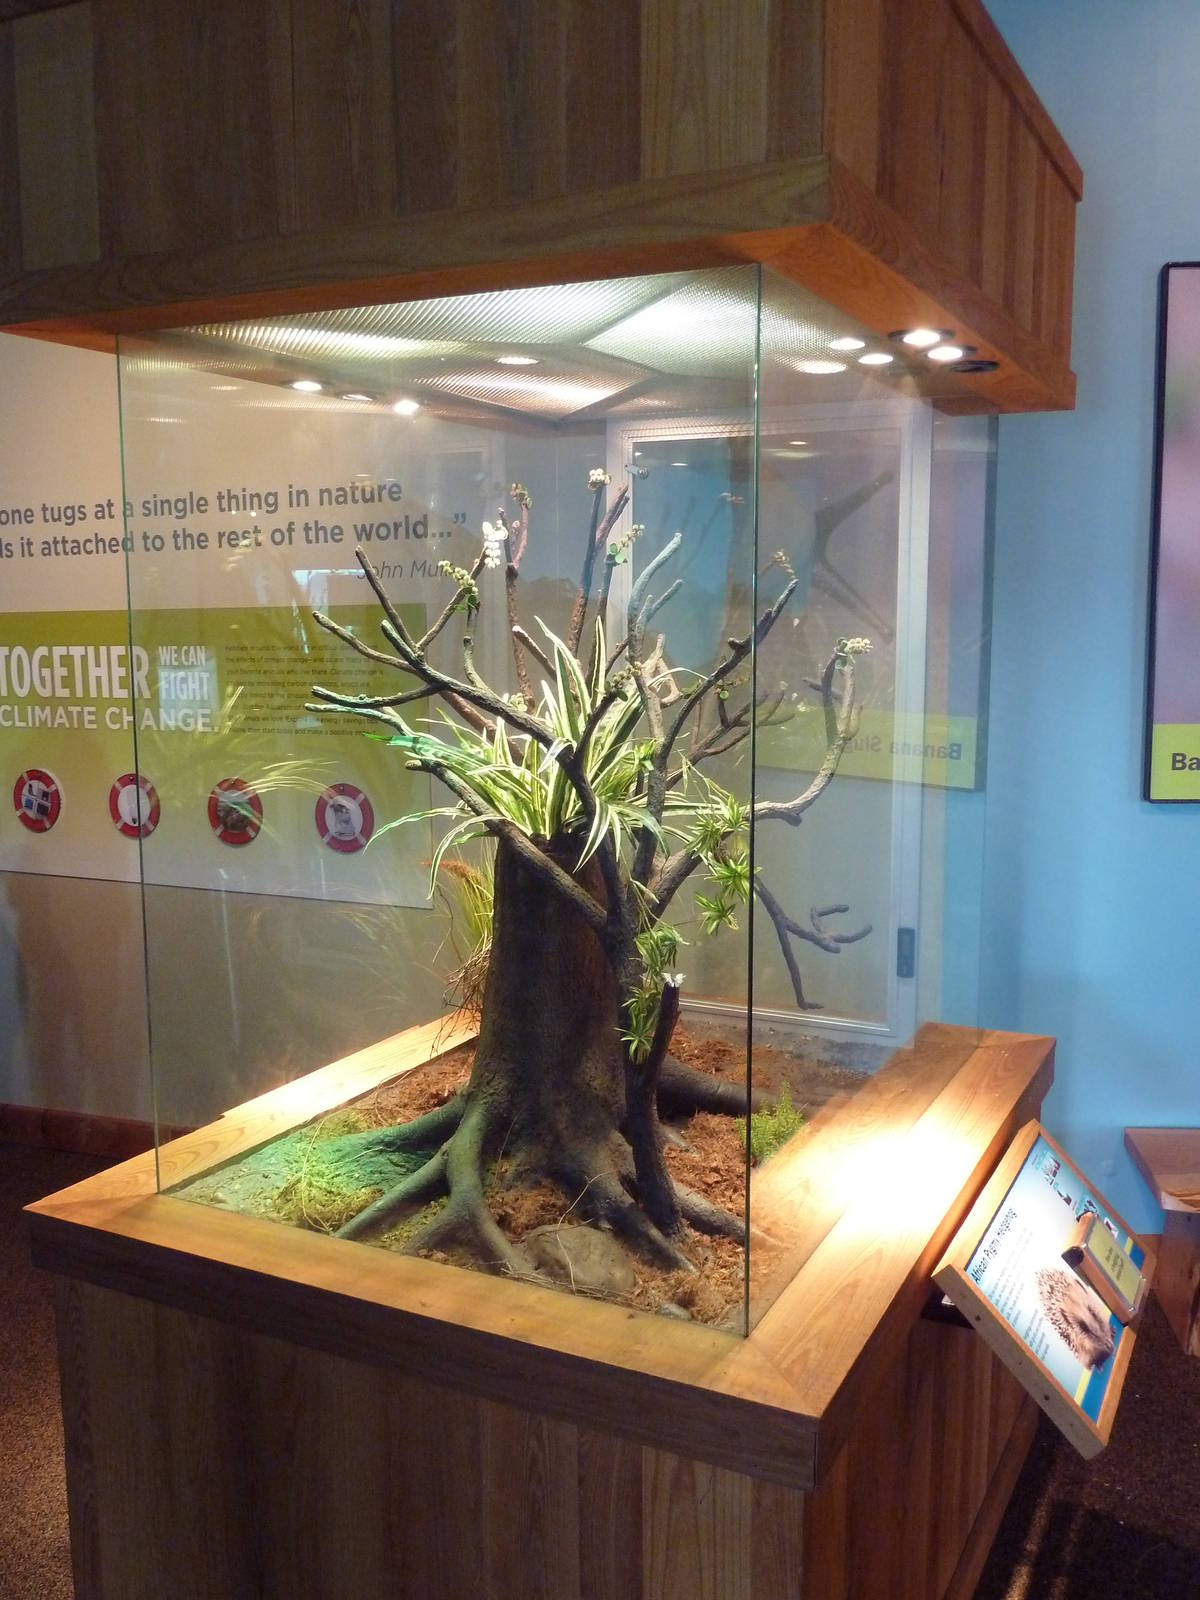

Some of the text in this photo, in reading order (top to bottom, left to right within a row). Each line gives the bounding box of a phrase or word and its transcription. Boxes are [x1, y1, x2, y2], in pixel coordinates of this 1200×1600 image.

[0, 481, 402, 526] one tugs at a single thing in nature
[20, 537, 34, 558] it
[41, 531, 134, 557] attached
[142, 531, 165, 552] to
[172, 528, 209, 551] the
[217, 525, 262, 548] rest
[270, 521, 296, 545] of
[303, 519, 344, 544] the
[0, 645, 152, 699] TOGETHER
[158, 645, 179, 666] WE
[182, 645, 207, 666] CAN
[160, 671, 210, 701] FIGHT
[0, 704, 98, 729] CLIMATE
